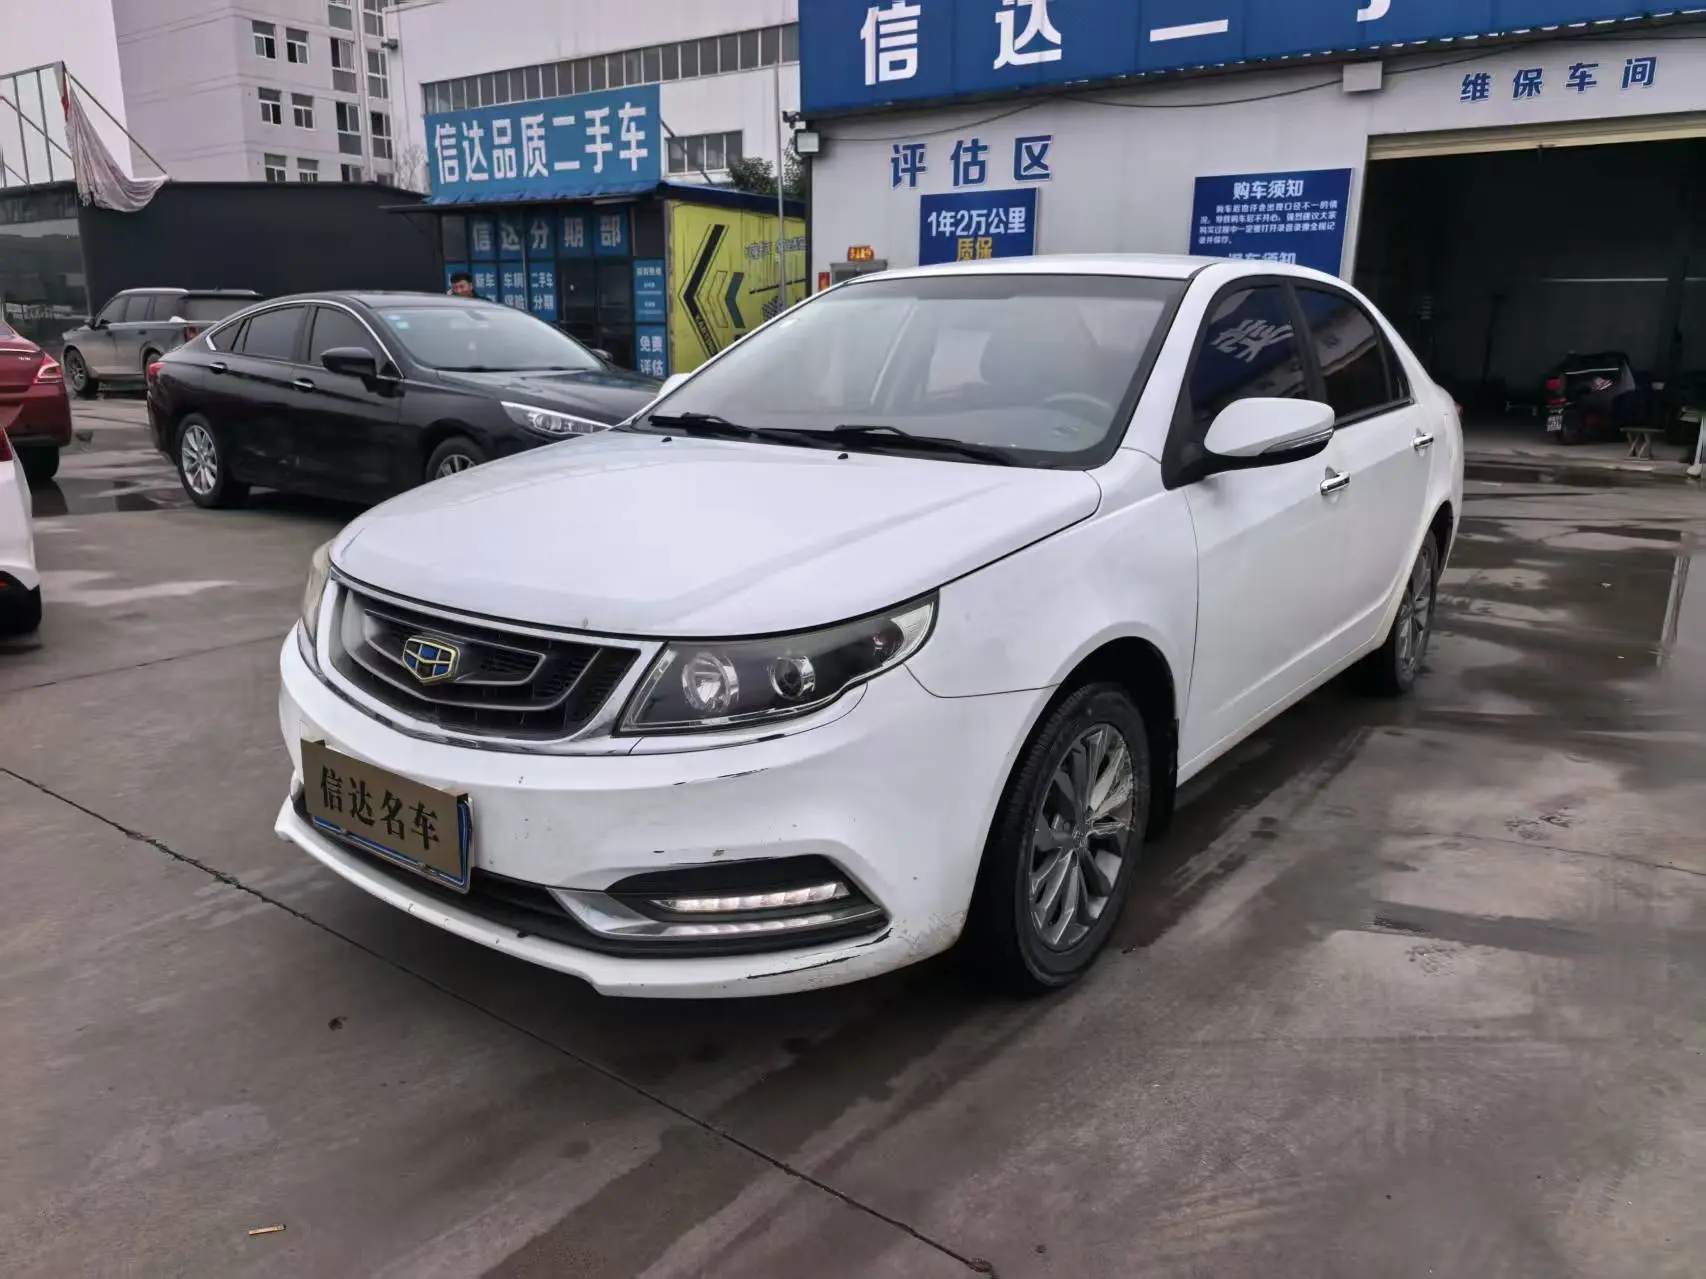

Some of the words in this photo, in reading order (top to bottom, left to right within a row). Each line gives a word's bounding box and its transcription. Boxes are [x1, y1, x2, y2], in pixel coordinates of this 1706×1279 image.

[1460, 56, 1657, 102] 维保车间
[434, 101, 648, 184] 信达品质二手车
[891, 134, 1052, 187] 评估区
[1232, 179, 1304, 200] 购车须知
[473, 215, 621, 252] 信达分期部
[927, 207, 1026, 237] 1年2万公里
[957, 236, 993, 262] 质保
[531, 272, 553, 288] 二手车
[639, 335, 663, 353] 免费
[640, 359, 663, 376] 评估
[320, 765, 440, 850] 信达名车
